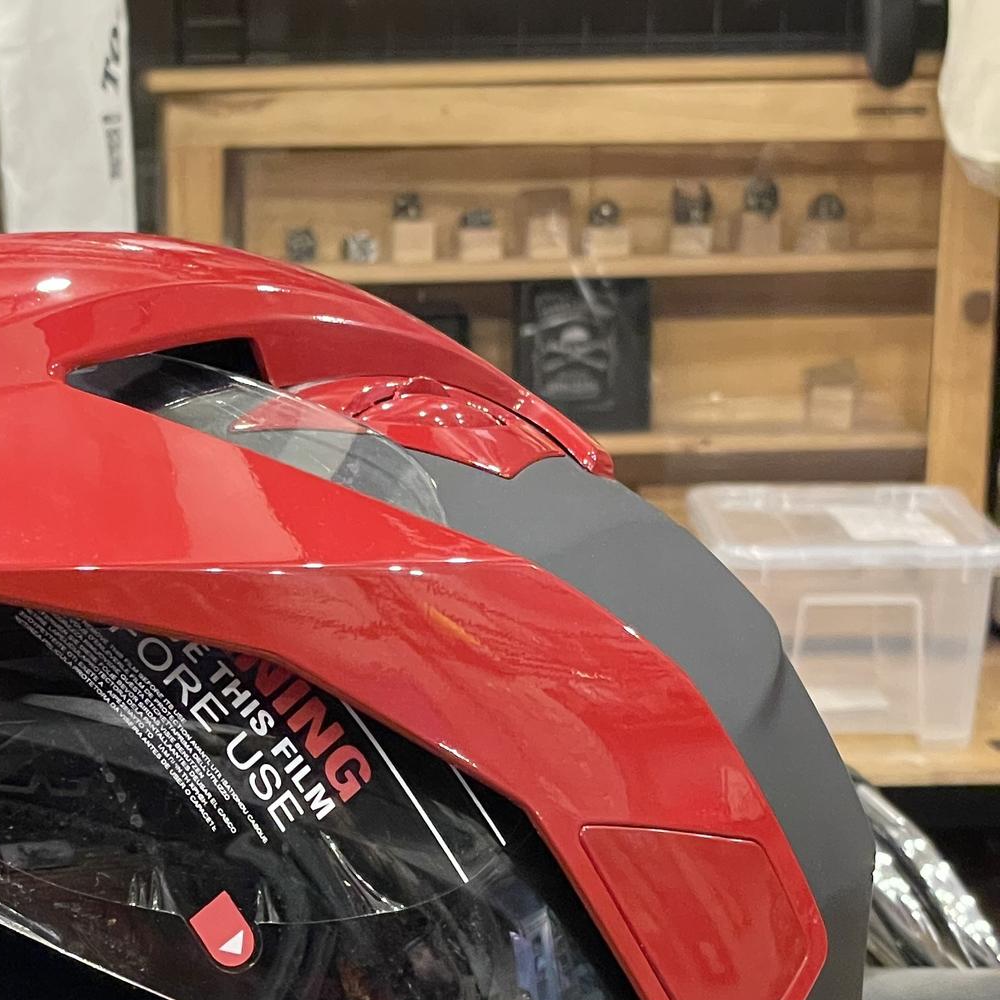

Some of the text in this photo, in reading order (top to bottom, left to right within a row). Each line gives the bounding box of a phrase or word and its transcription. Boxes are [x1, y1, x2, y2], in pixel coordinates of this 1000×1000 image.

[119, 672, 146, 700] QUESTA
[136, 671, 165, 700] BEFORE
[127, 630, 305, 833] ORE USE
[209, 660, 275, 737] THIS
[270, 736, 336, 820] FILM
[152, 697, 192, 741] PROTECTION
[246, 812, 269, 844] CASQUE
[173, 741, 205, 779] BENUTZEN
[188, 793, 219, 832] CAPACETE
[216, 806, 238, 834] CASCO
